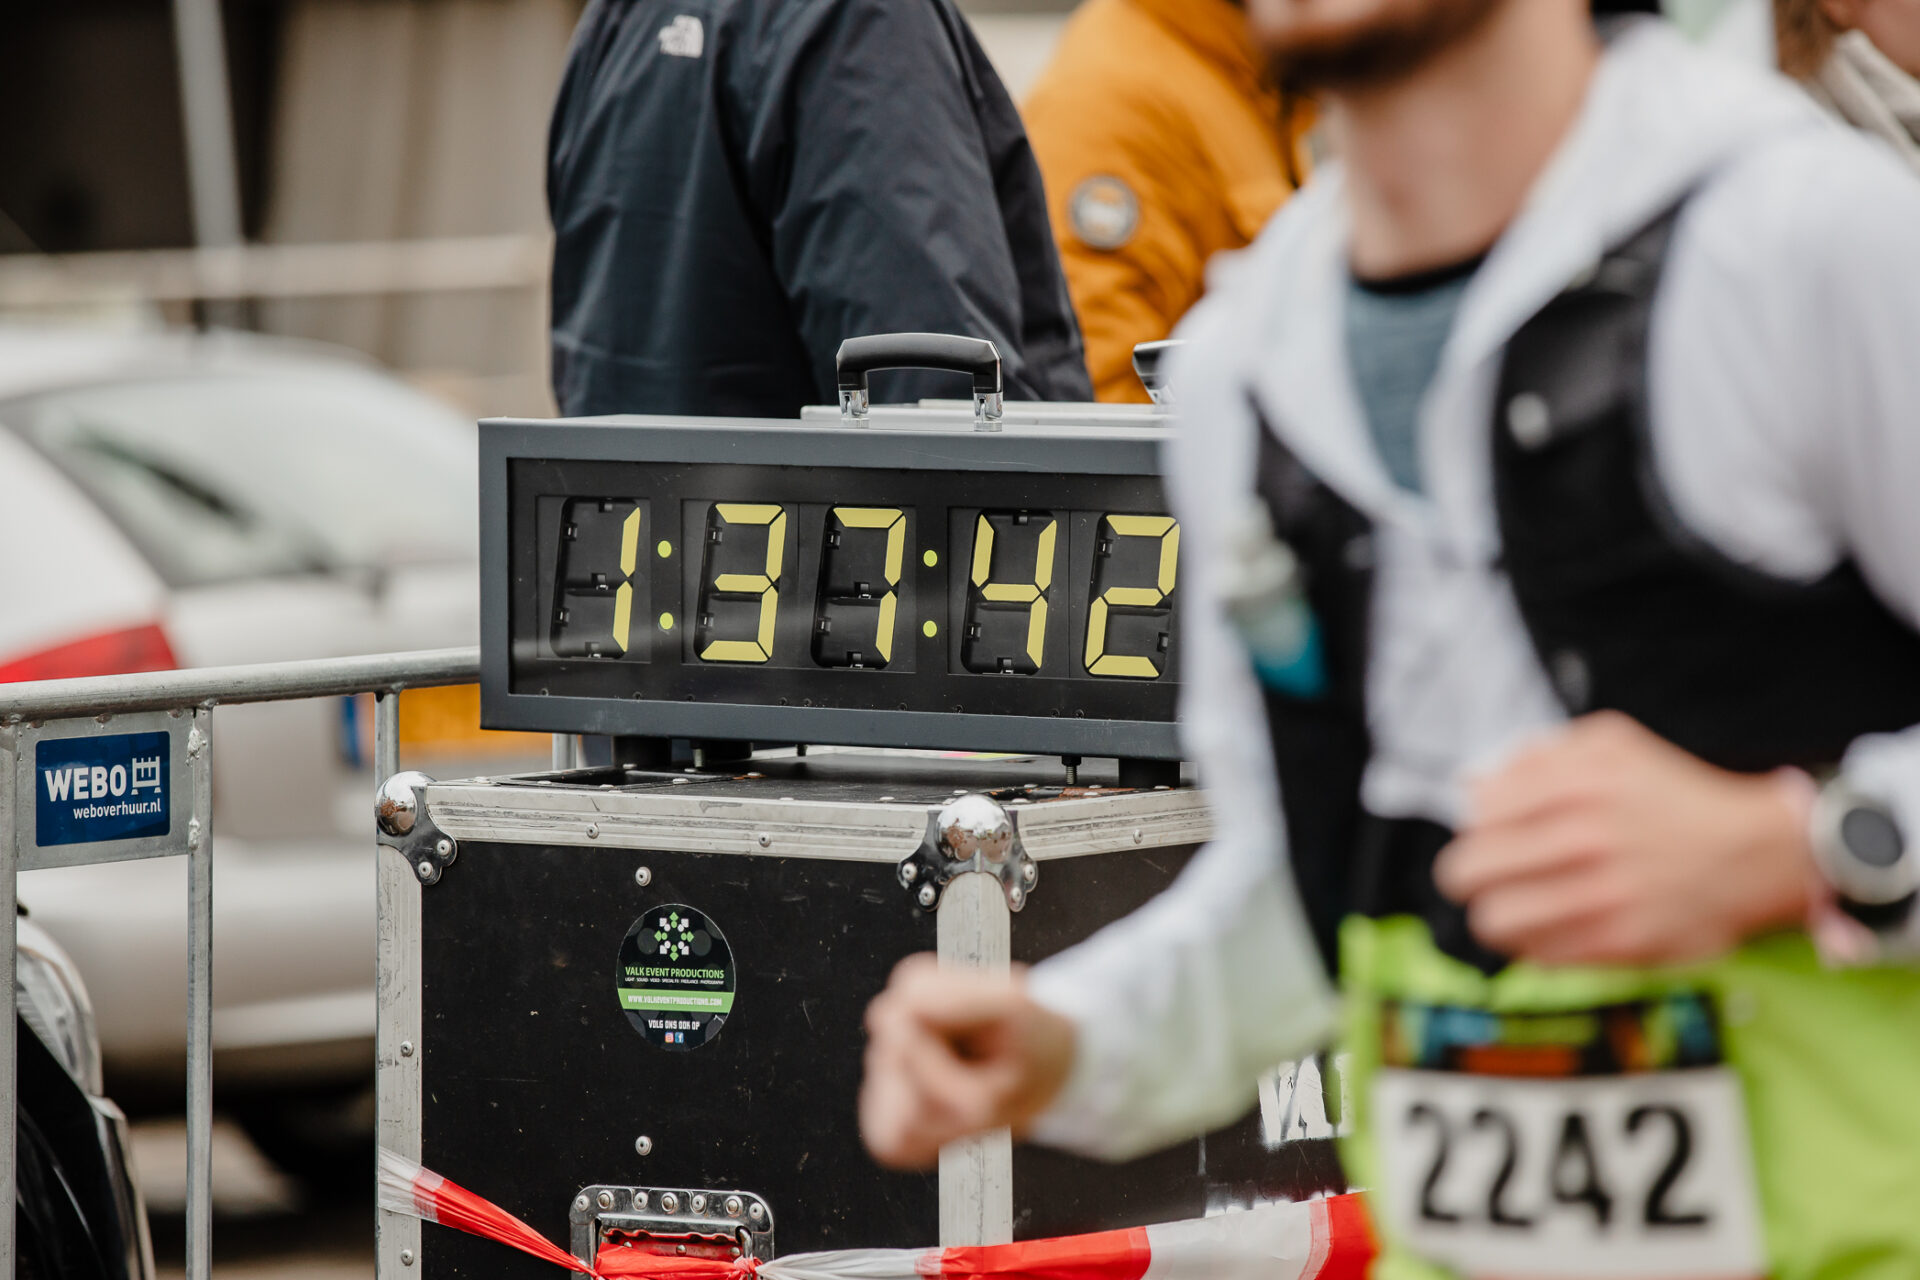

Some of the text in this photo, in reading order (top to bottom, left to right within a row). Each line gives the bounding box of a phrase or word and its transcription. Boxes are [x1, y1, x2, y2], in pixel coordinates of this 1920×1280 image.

[611, 502, 1181, 679] 1:37:42
[44, 764, 127, 803] WEBO
[73, 798, 162, 820] weboverhuur.nl
[625, 966, 725, 979] VALK EVENT PRODUCTIONS
[648, 1019, 701, 1030] VOLG ONS OOK OP
[1406, 1102, 1711, 1228] 2242
